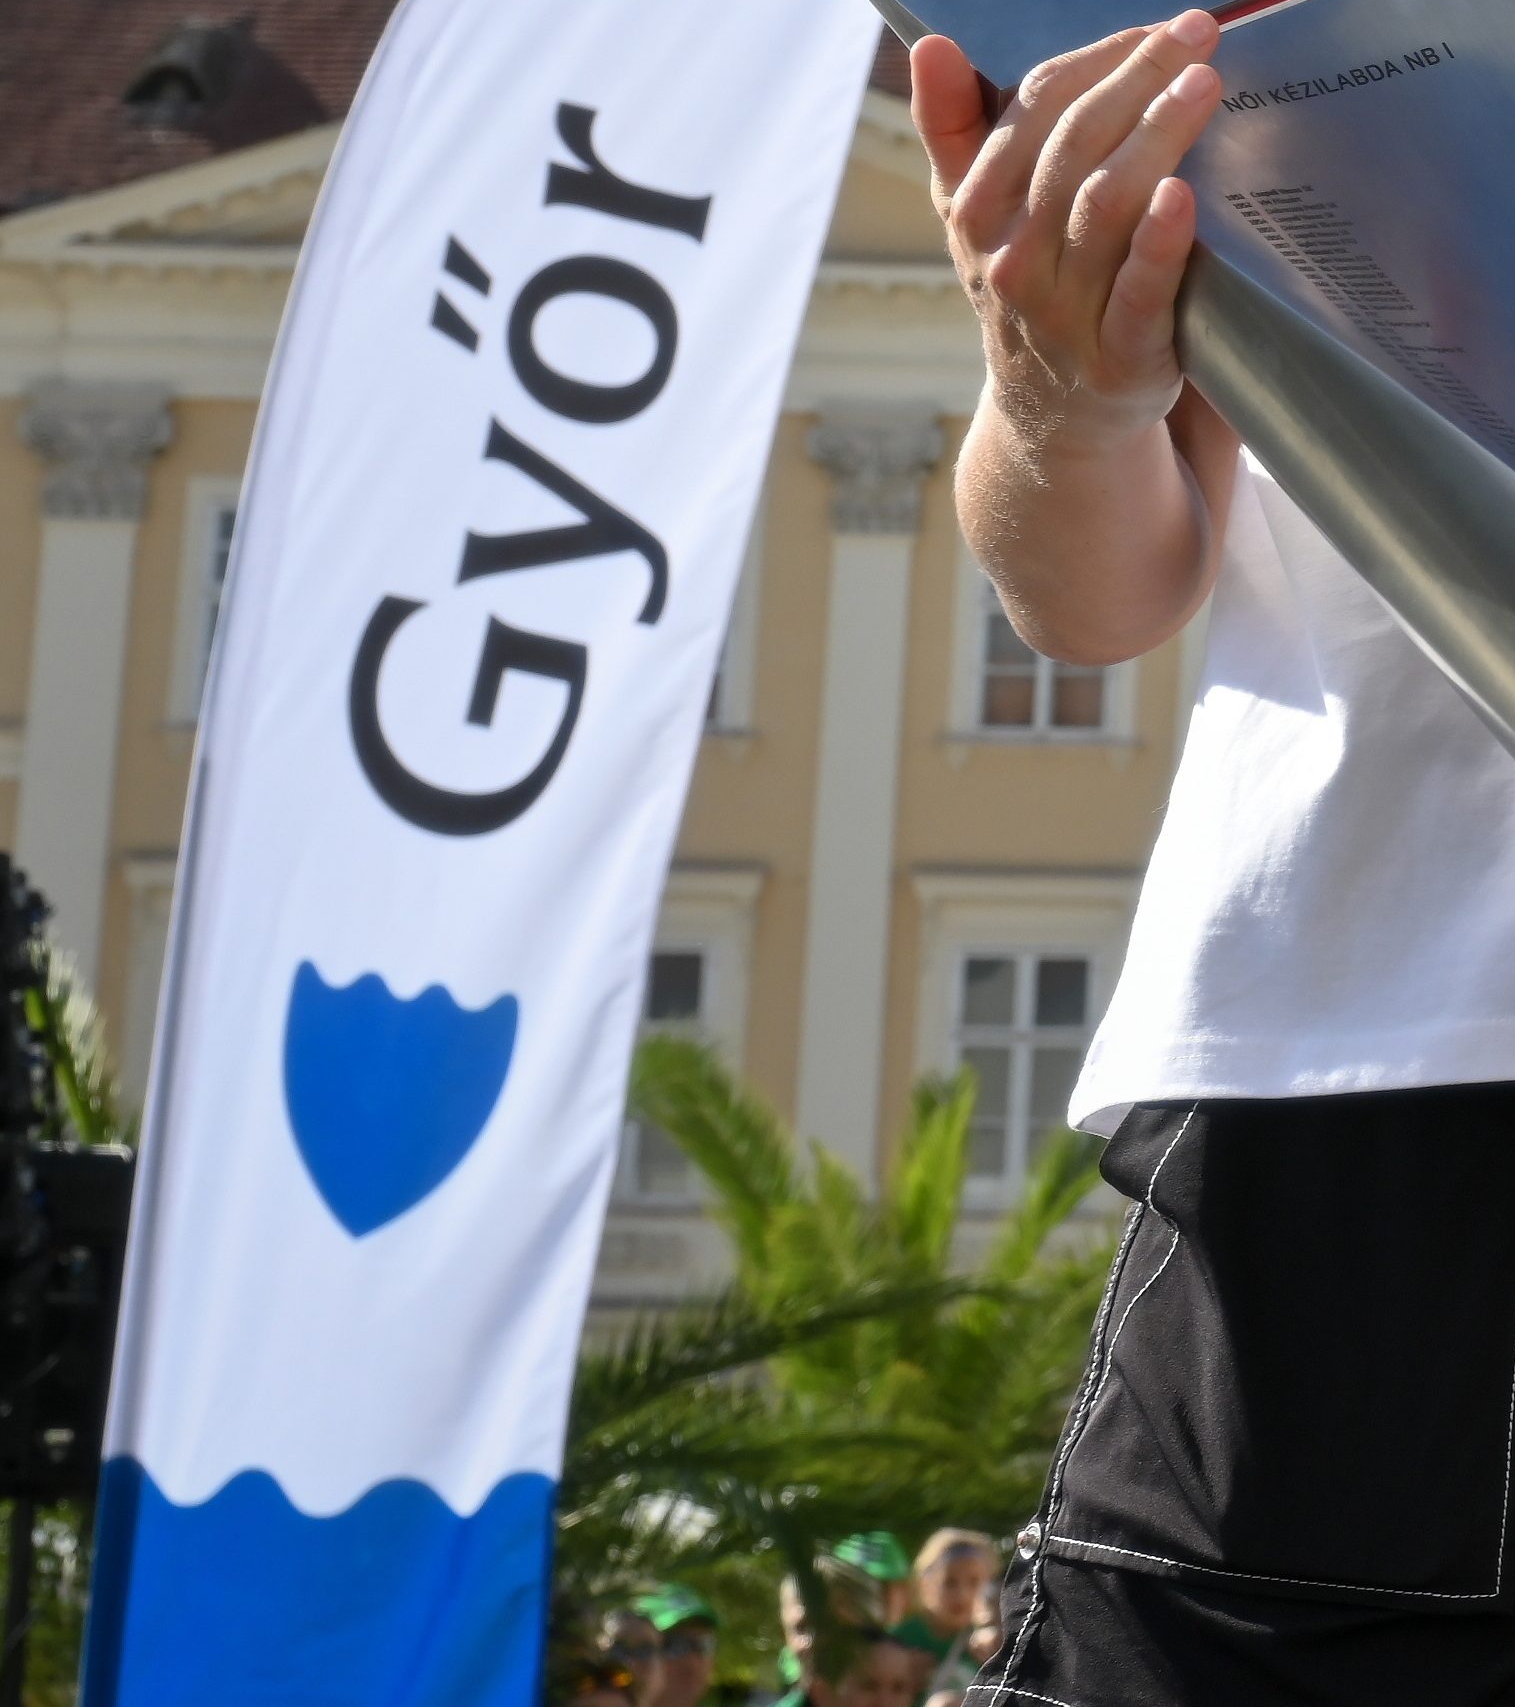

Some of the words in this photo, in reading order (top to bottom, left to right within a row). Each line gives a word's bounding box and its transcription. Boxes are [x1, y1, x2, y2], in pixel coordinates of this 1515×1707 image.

[1267, 59, 1405, 104] KÉZILABDA
[1403, 46, 1441, 71] NB
[1441, 41, 1455, 59] I
[347, 101, 715, 840] Győr
